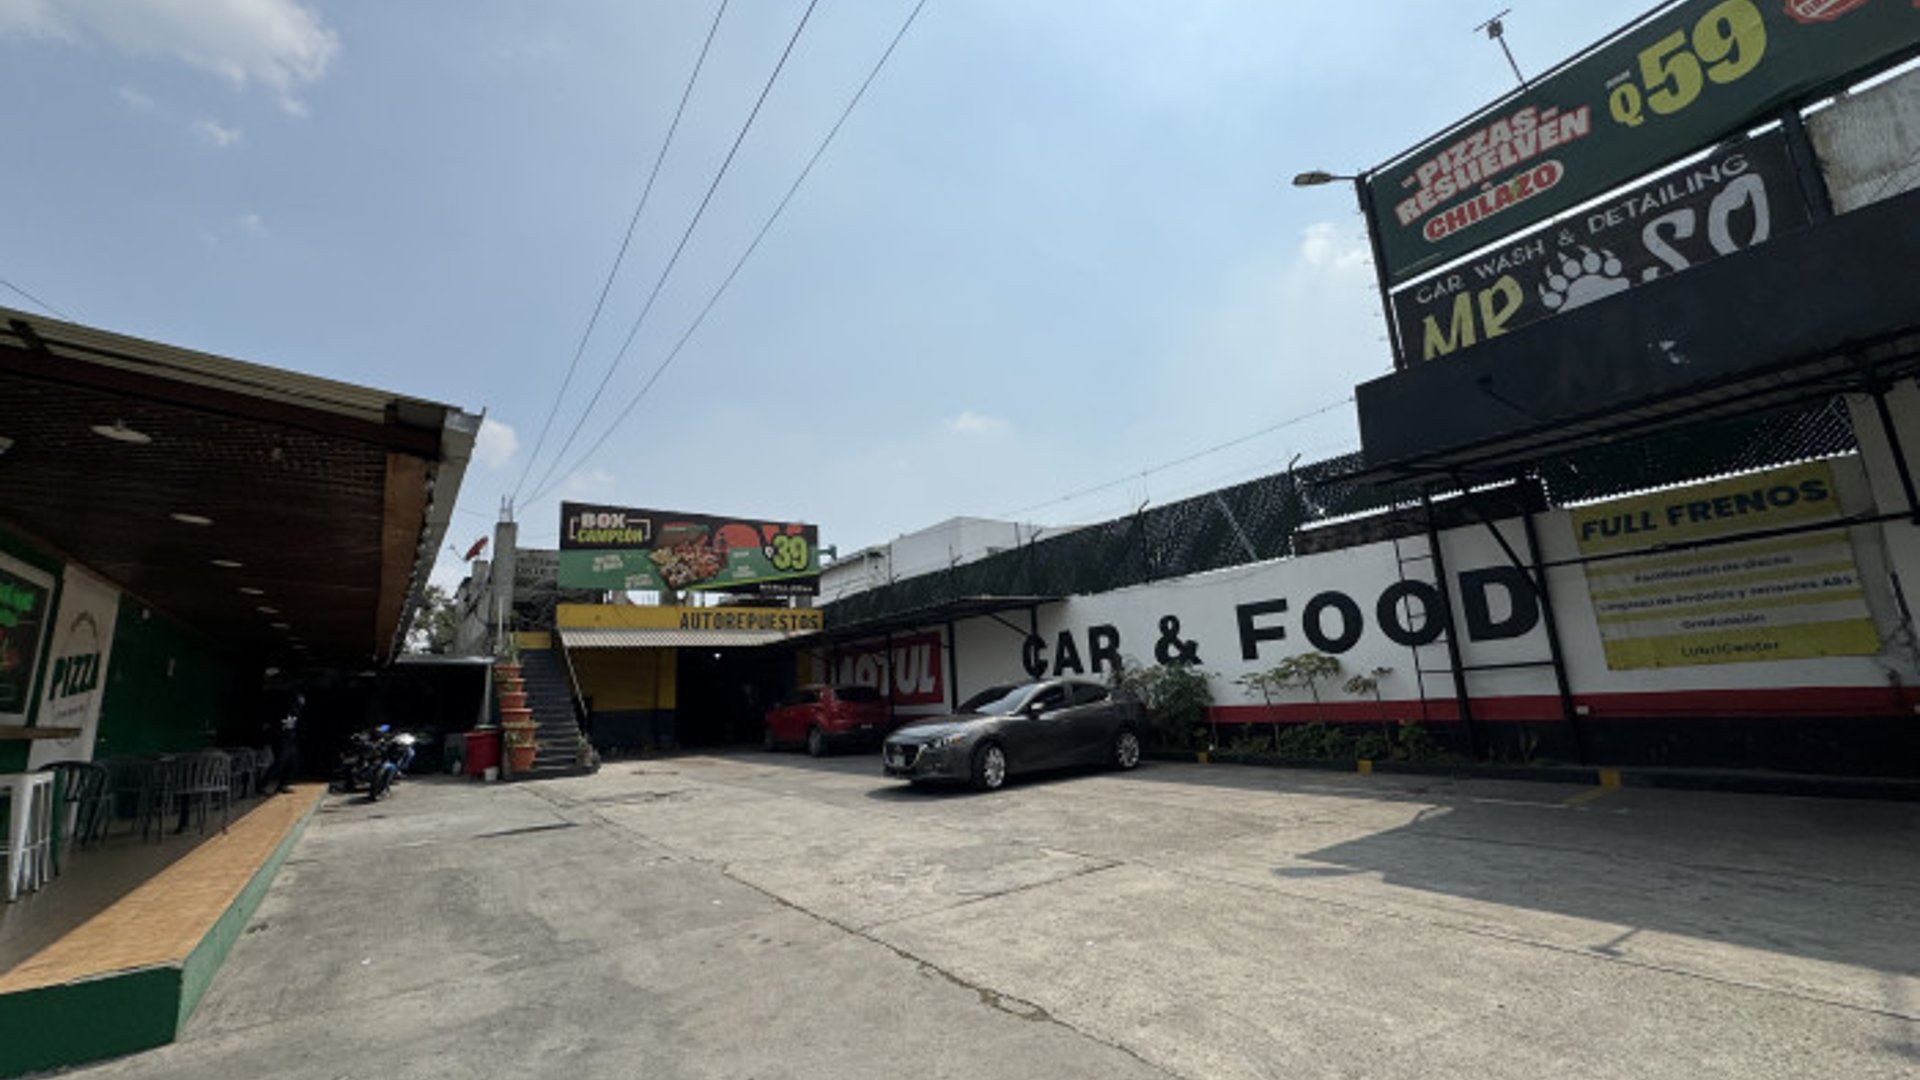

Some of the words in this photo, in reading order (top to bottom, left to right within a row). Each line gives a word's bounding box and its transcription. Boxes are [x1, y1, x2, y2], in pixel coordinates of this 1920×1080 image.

[1395, 105, 1592, 227] RESUELVEN
[1416, 277, 1465, 304] CAR
[1473, 238, 1546, 281] WASH
[1556, 228, 1576, 247] &
[1587, 153, 1750, 236] DETAILING
[1426, 163, 1558, 239] CHILAZO
[580, 513, 626, 529] BOX
[1581, 511, 1657, 542] FULL
[1667, 480, 1829, 528] FRENOS
[680, 611, 820, 630] AUTOREPUESTOS
[1022, 624, 1123, 679] CAR
[1154, 614, 1202, 667] &
[1235, 565, 1541, 661] FOOD
[49, 653, 100, 701] PIZZA
